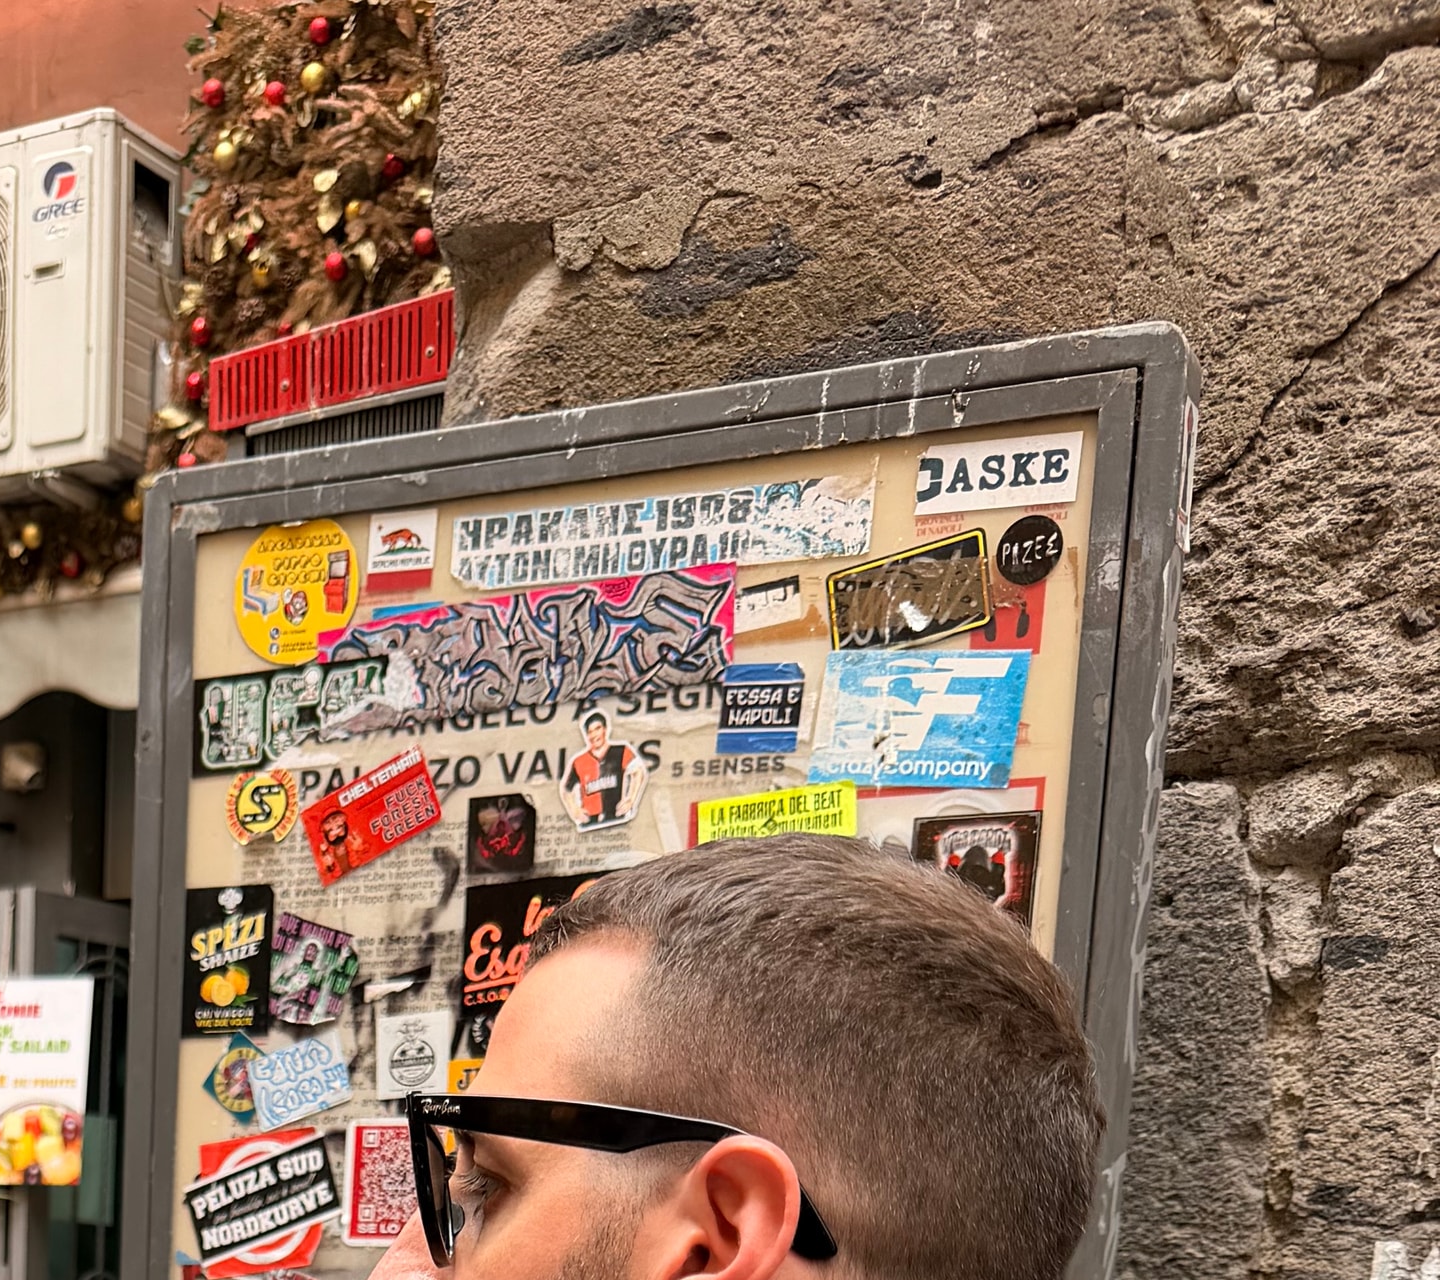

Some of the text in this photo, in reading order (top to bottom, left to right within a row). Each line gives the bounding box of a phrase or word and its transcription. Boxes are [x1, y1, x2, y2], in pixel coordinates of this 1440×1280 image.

[32, 198, 85, 222] GREE
[727, 704, 793, 727] NAPOLI
[692, 755, 786, 777] SENSES
[385, 775, 427, 809] FUCK
[710, 806, 724, 827] LA
[789, 793, 810, 815] DEL
[814, 789, 843, 811] BEAT
[370, 791, 431, 834] FOREST
[382, 803, 437, 844] GREEN
[276, 1146, 325, 1179] SUD
[201, 1181, 334, 1251] NORDKURVE
[357, 1222, 378, 1235] SE
